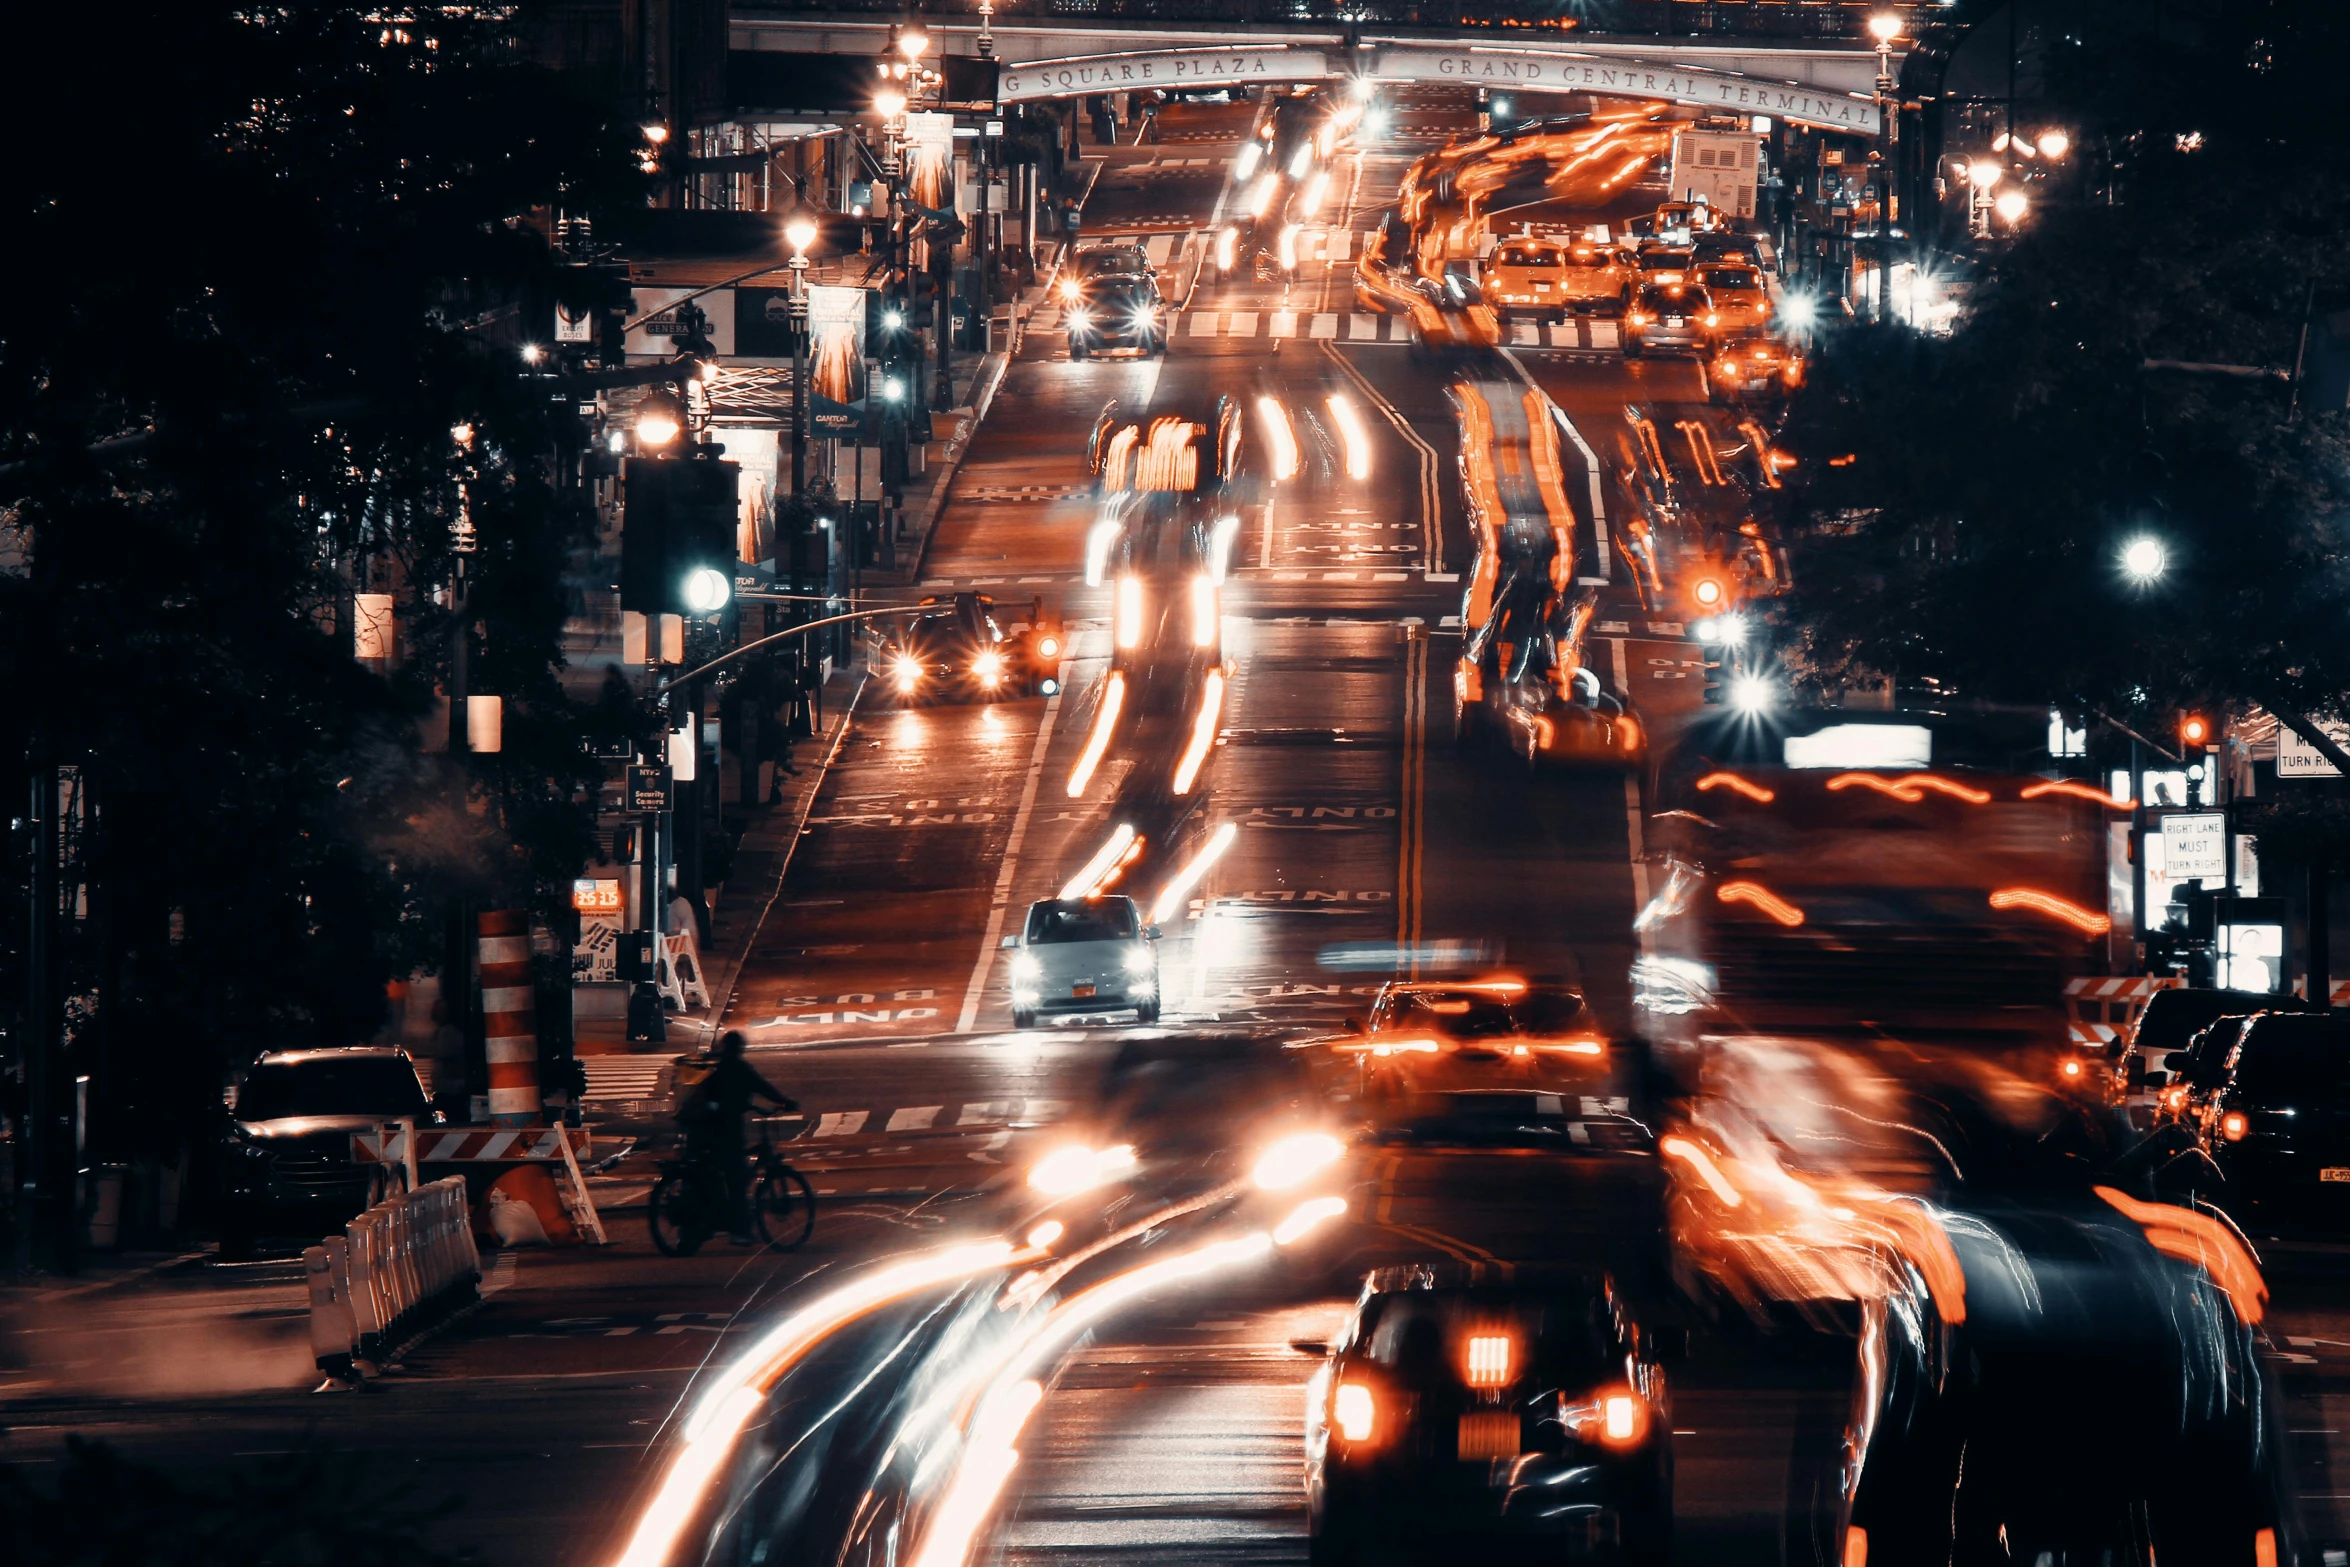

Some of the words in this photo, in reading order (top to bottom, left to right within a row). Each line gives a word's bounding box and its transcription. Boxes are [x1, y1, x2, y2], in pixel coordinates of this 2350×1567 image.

[1041, 64, 1153, 89] SQUARE
[1175, 58, 1266, 76] PLAZA
[1439, 59, 1541, 78] GRAND
[1563, 66, 1696, 95] CENTRAL
[1719, 84, 1870, 124] TERMINAL
[647, 325, 712, 333] GENERAN
[735, 577, 755, 585] TOR
[2282, 756, 2311, 767] TURN
[635, 790, 665, 799] Security
[1232, 807, 1397, 818] ONLY
[2167, 825, 2193, 834] RIGHT
[2197, 823, 2220, 833] LANE
[2179, 841, 2208, 852] MUST
[2168, 861, 2191, 870] TURN
[2195, 859, 2221, 869] RIGHT
[598, 958, 616, 969] JUU
[783, 989, 935, 1007] BUS
[752, 1007, 938, 1028] ONLY
